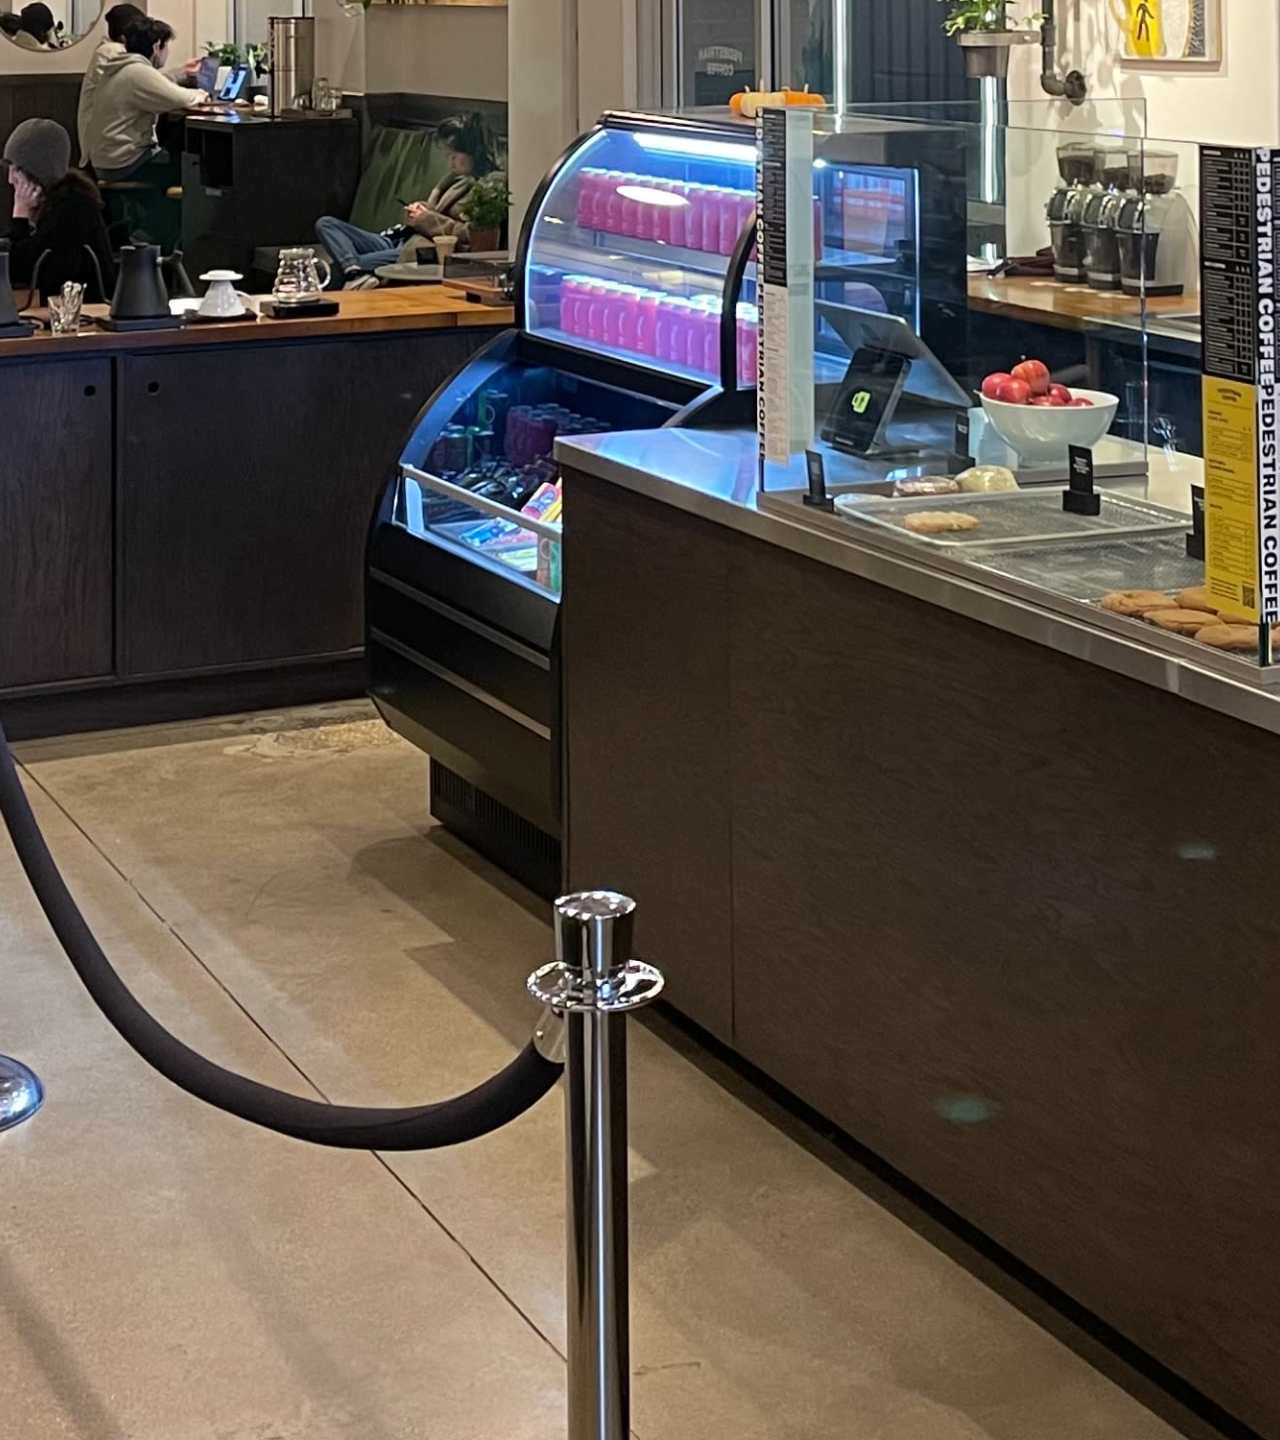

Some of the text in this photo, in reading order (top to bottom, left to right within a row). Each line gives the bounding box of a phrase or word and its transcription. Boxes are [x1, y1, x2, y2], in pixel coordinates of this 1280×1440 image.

[1256, 148, 1275, 386] PEDESTRIAN COFFEE
[1261, 384, 1278, 623] PEDESTRIAN COFFEE
